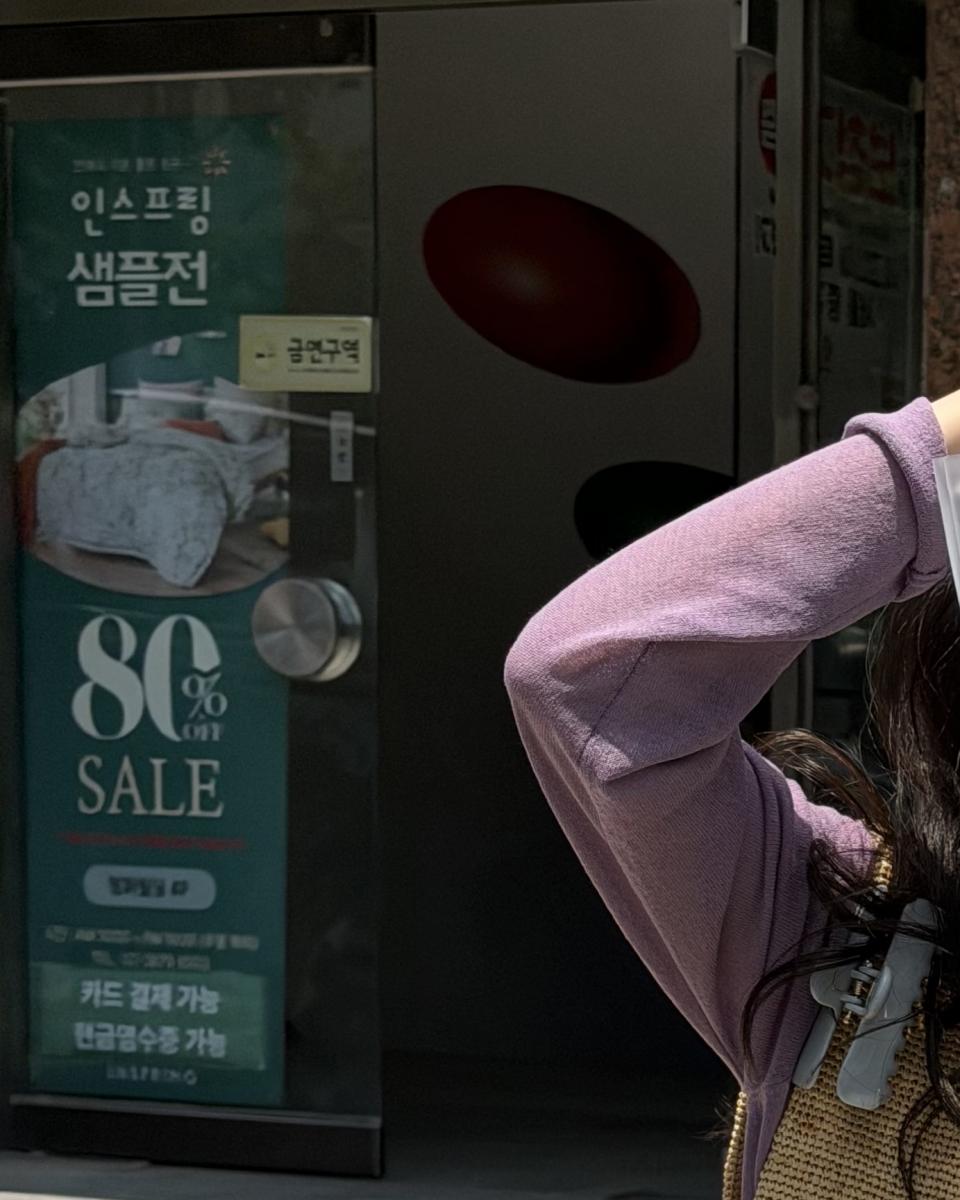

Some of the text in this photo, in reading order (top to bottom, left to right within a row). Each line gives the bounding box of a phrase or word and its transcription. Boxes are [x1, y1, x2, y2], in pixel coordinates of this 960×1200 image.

[70, 186, 211, 237] 인스프링
[67, 249, 208, 307] 샘플전
[287, 337, 361, 365] 금연구역
[77, 754, 224, 818] SALE
[80, 979, 220, 1014] 카드 결제 가능
[185, 1027, 226, 1058] 가능
